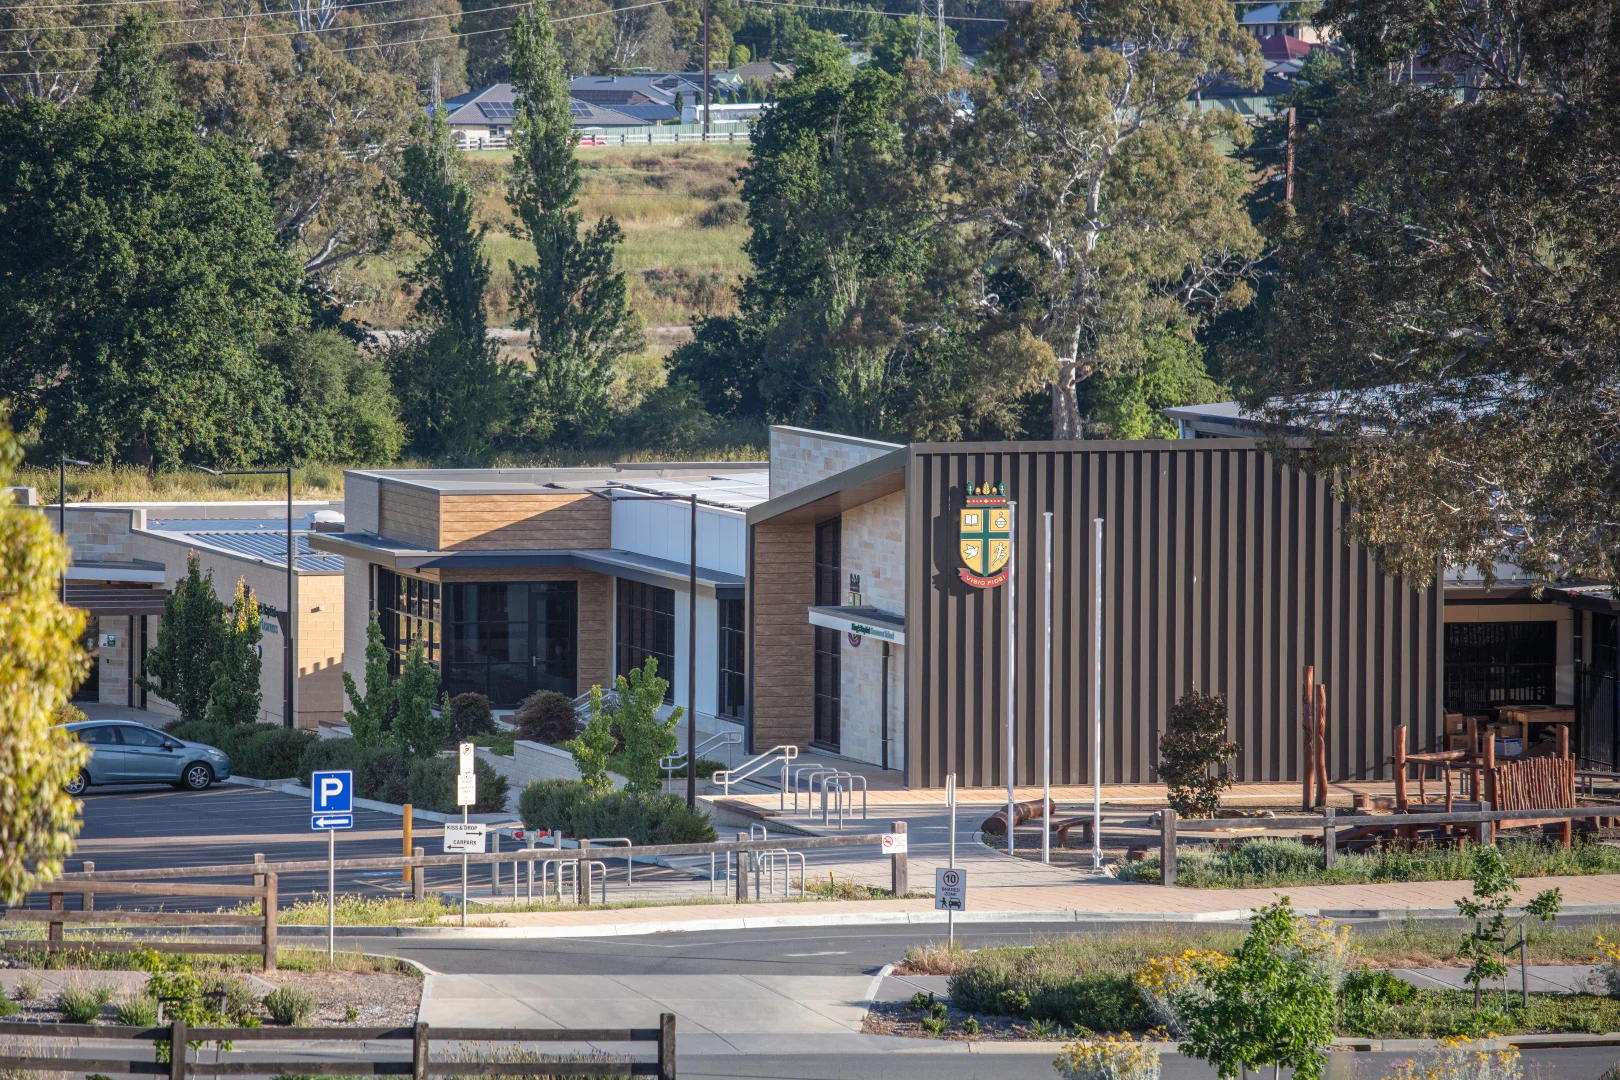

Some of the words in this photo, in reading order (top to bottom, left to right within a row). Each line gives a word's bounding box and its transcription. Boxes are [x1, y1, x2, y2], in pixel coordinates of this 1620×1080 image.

[966, 575, 986, 586] VISIO
[987, 575, 1006, 585] FIDEI
[321, 778, 343, 807] P
[946, 874, 956, 884] 10
